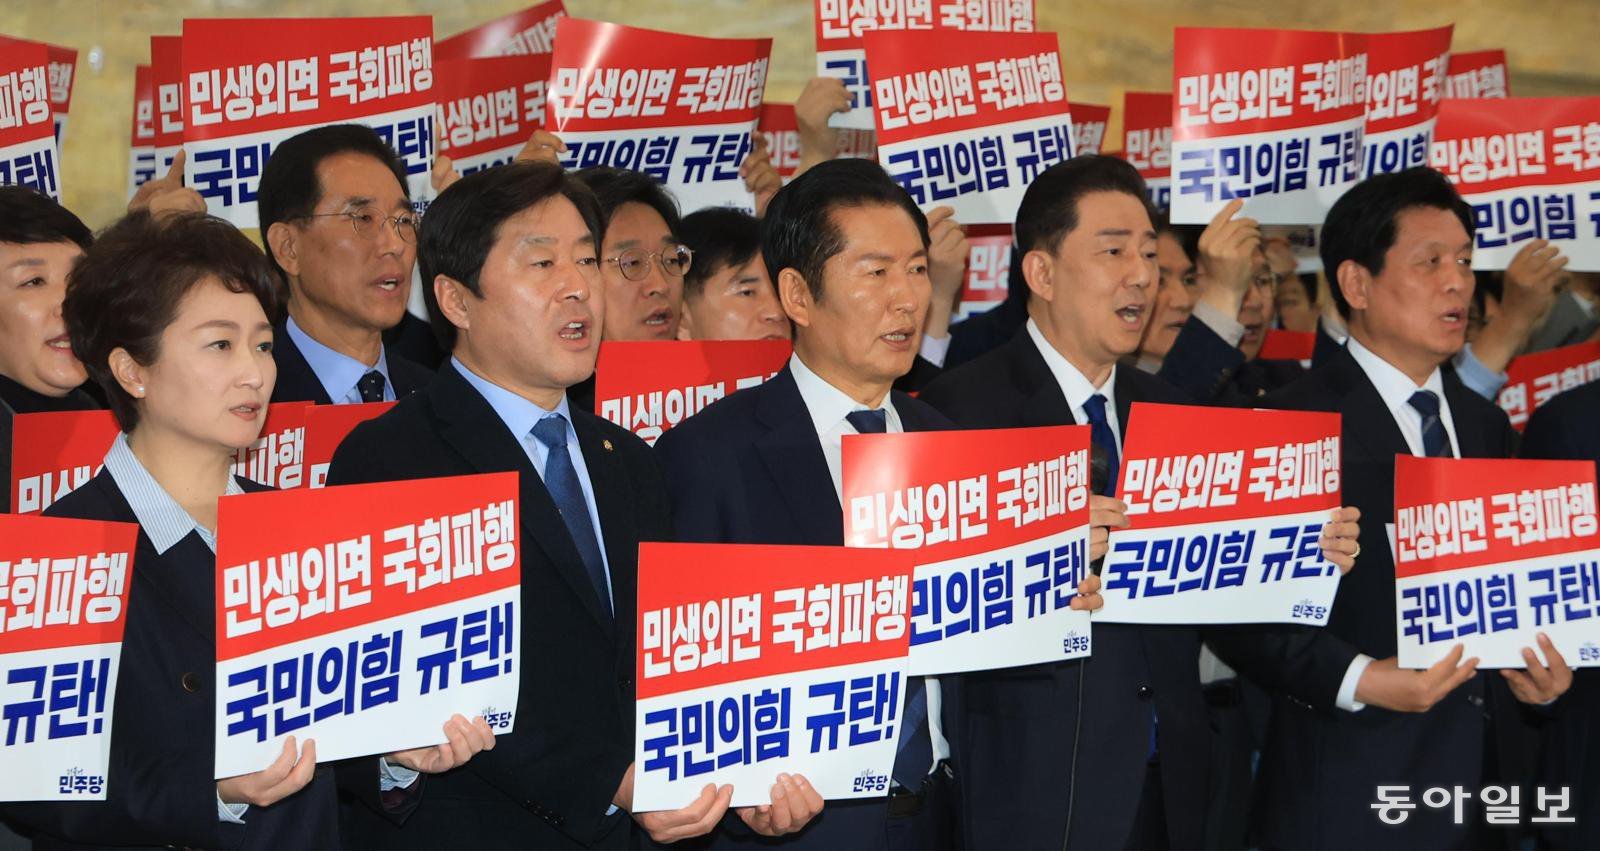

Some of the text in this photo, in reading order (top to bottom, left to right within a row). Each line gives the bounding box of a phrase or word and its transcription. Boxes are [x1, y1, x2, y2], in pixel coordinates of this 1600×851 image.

[189, 37, 433, 126] 민생외면 국회파행
[557, 57, 769, 118] 민생외면 국회파행
[875, 51, 1064, 130] 민생외면 국회파행
[1178, 53, 1367, 126] 민생외면 국회파행
[888, 135, 1009, 205] 국민의힘
[1179, 137, 1310, 203] 국민의힘
[1430, 130, 1547, 184] 민생외면
[232, 427, 305, 490] 파행
[1123, 436, 1340, 516] 민생외면 국회파행
[850, 449, 1088, 549] 민생외면 국회파행
[1397, 482, 1599, 562] 민생외면 국회파행
[223, 499, 515, 639] 민생외면 국회파행
[1106, 529, 1256, 599] 국민의힘
[1402, 561, 1600, 645] 국민의힘 규탄!
[643, 574, 909, 679] 민생외면 국회파행
[3, 657, 110, 746] 규탄!
[226, 601, 513, 743] 국민의힘 규탄!
[644, 671, 900, 782] 국민의힘 규탄!
[59, 775, 104, 794] 민주당
[853, 775, 888, 792] 민주당
